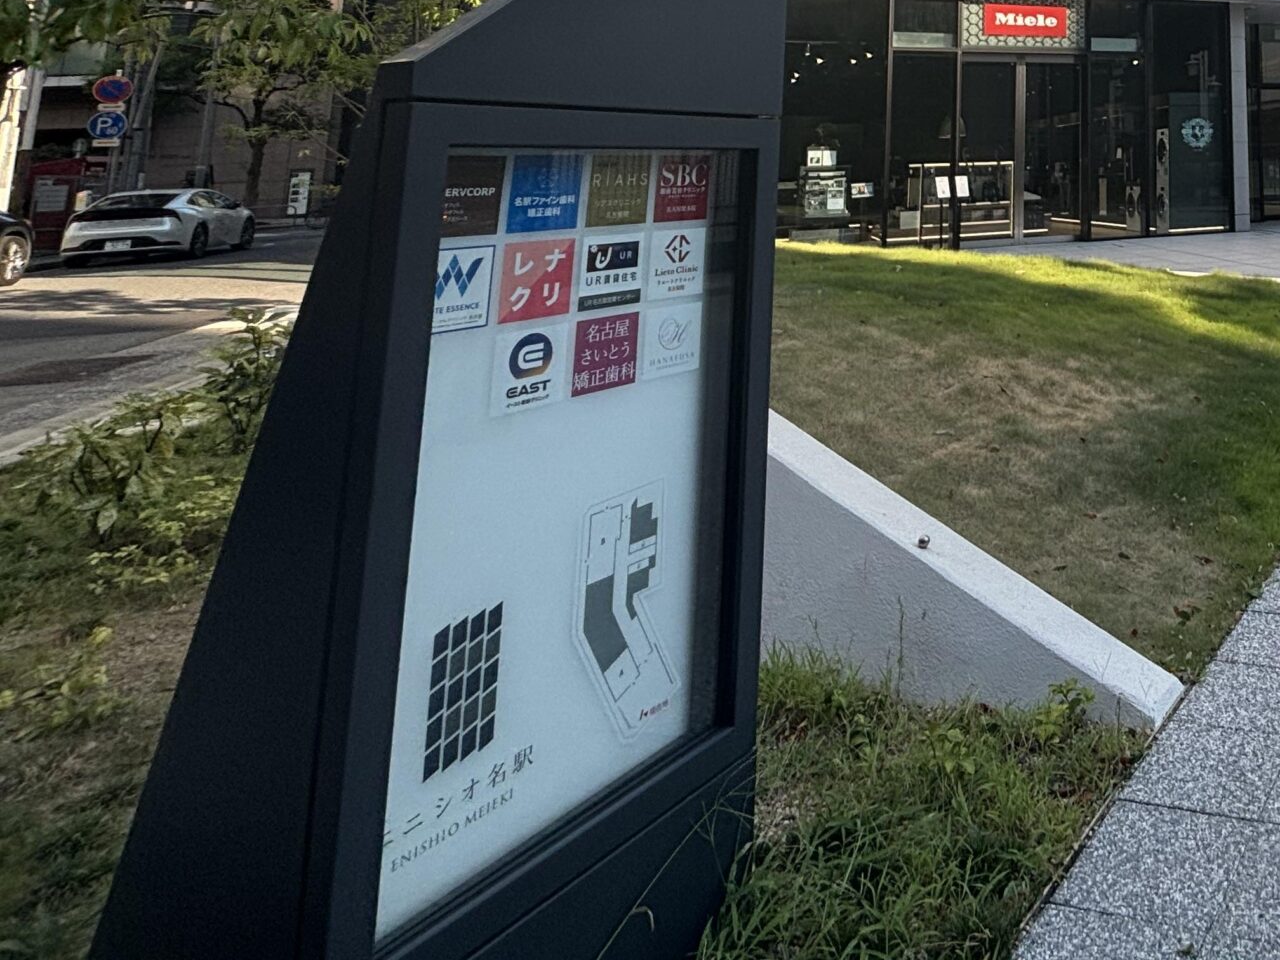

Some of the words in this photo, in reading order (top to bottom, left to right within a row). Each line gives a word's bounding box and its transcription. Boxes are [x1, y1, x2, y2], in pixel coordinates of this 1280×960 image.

[995, 12, 1058, 27] Miele
[96, 117, 113, 135] P
[660, 164, 707, 187] SBC
[444, 187, 496, 197] ERVCORP
[514, 248, 567, 276] レナ
[619, 250, 633, 260] UR
[676, 265, 698, 274] Clinic
[446, 302, 480, 313] ESSENCE
[585, 319, 630, 343] 名古屋
[581, 342, 630, 366] さいとう
[573, 360, 635, 391] 矯正歯科
[506, 379, 552, 399] EAST
[390, 822, 460, 872] ENISHIO
[464, 788, 514, 828] MEIEKI
